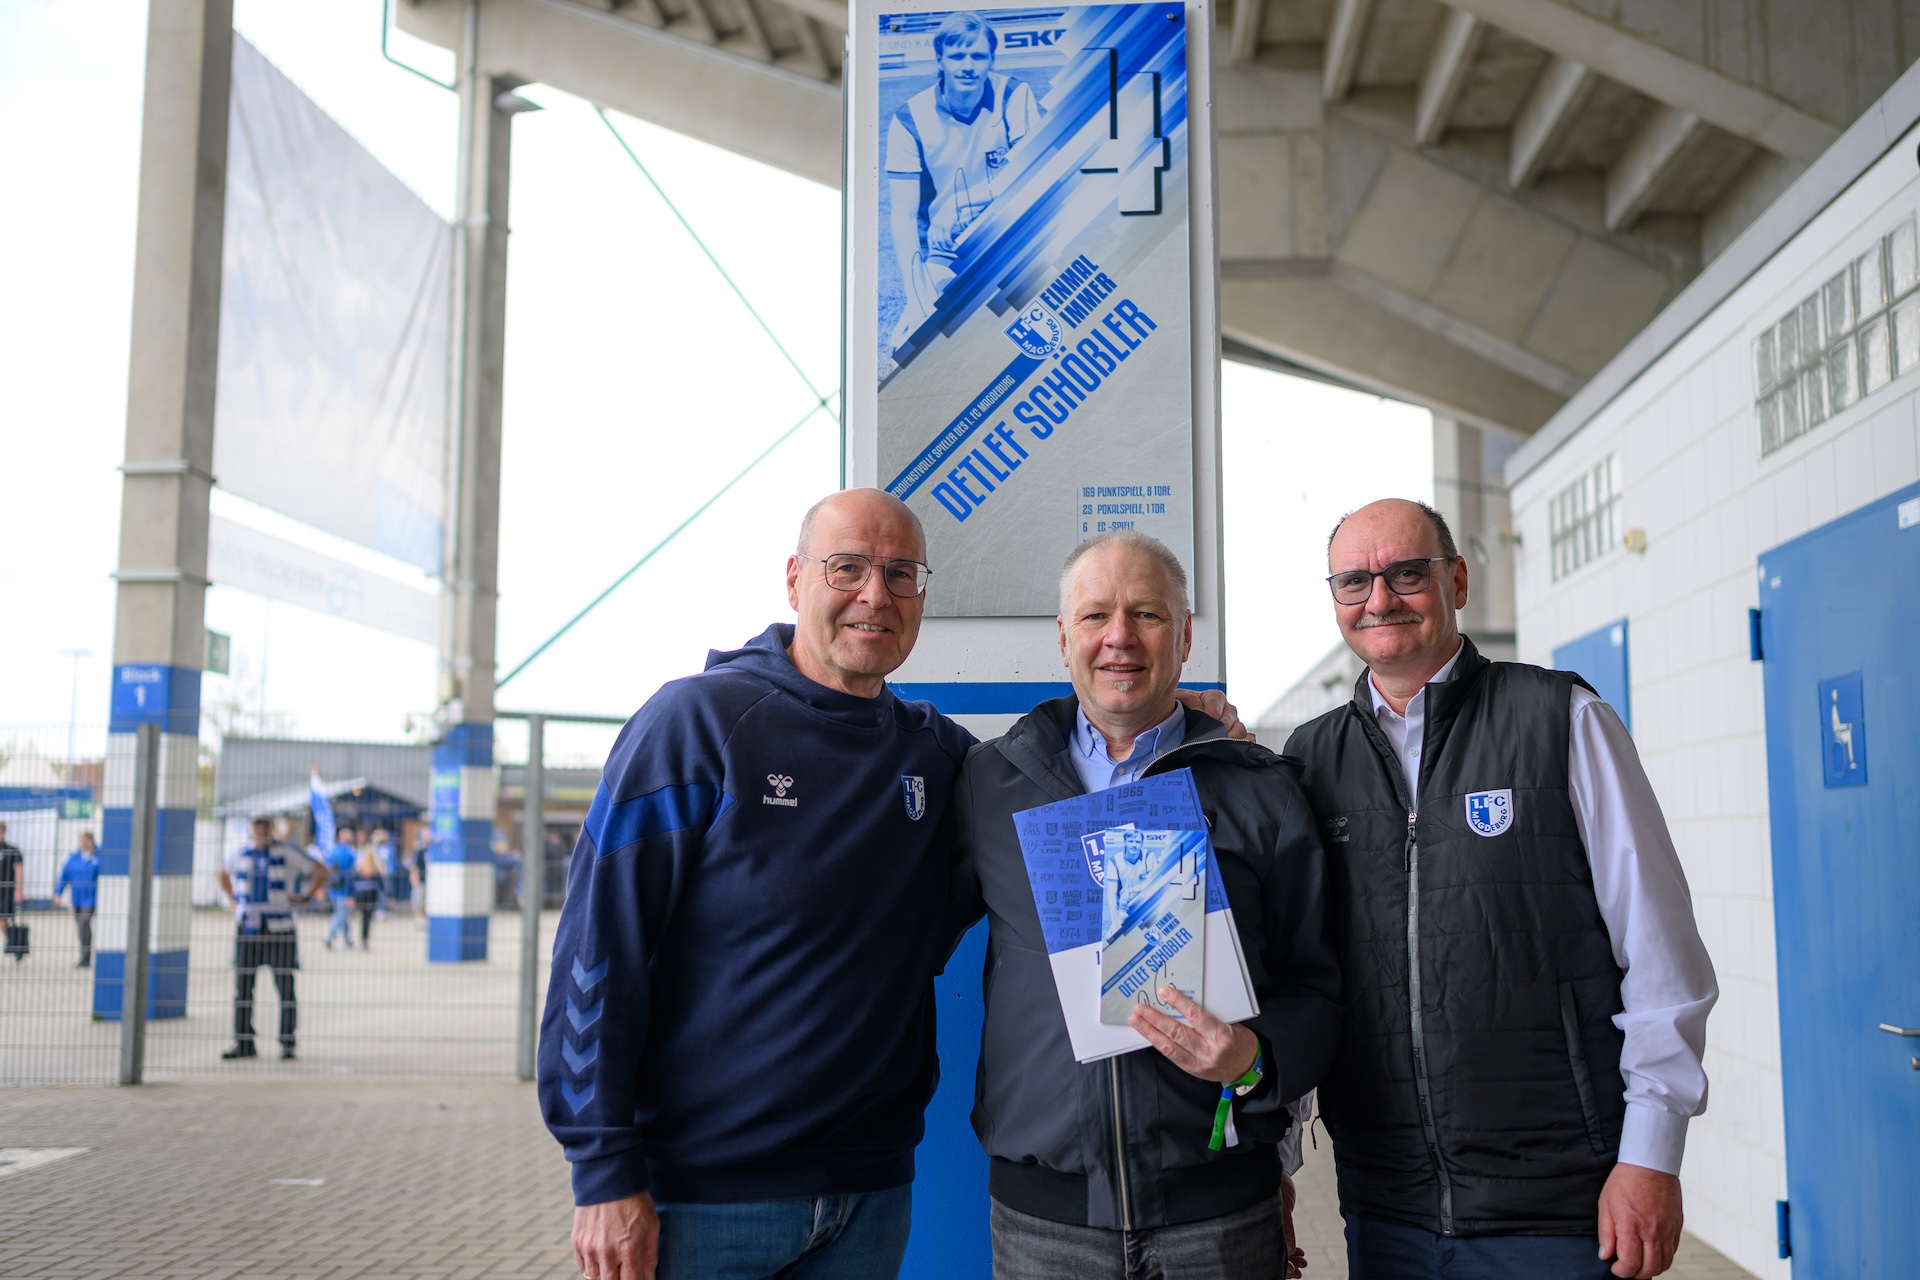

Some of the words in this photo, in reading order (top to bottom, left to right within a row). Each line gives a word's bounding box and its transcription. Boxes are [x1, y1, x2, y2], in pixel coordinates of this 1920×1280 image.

[1039, 253, 1099, 312] EINMAL
[1058, 272, 1118, 329] IMMER
[1022, 318, 1060, 355] MAGDEBURG
[931, 432, 958, 459] SPIELER
[953, 420, 969, 437] DES
[969, 407, 982, 420] FC
[976, 374, 1016, 413] MAGDEBURG
[930, 420, 1029, 522] DETLEF
[1082, 487, 1095, 497] 169
[1097, 486, 1146, 497] PUNKTSPIELE,
[1146, 486, 1152, 496] 8
[1153, 486, 1171, 496] TORE
[1082, 504, 1093, 515] 25
[1097, 503, 1145, 515] POKALSPIELE,
[1146, 503, 1150, 514] 1
[1151, 503, 1165, 514] TOR
[1082, 521, 1088, 532] 6
[1097, 521, 1106, 532] EC
[121, 666, 162, 684] Block
[134, 684, 146, 707] 1
[762, 794, 798, 807] hummel
[1118, 785, 1144, 800] 1965
[1471, 808, 1508, 832] MAGDEBURG
[1060, 859, 1080, 870] 1974
[1060, 928, 1080, 938] 1974
[1161, 918, 1181, 936] IMMER
[1118, 965, 1150, 998] DETLEF
